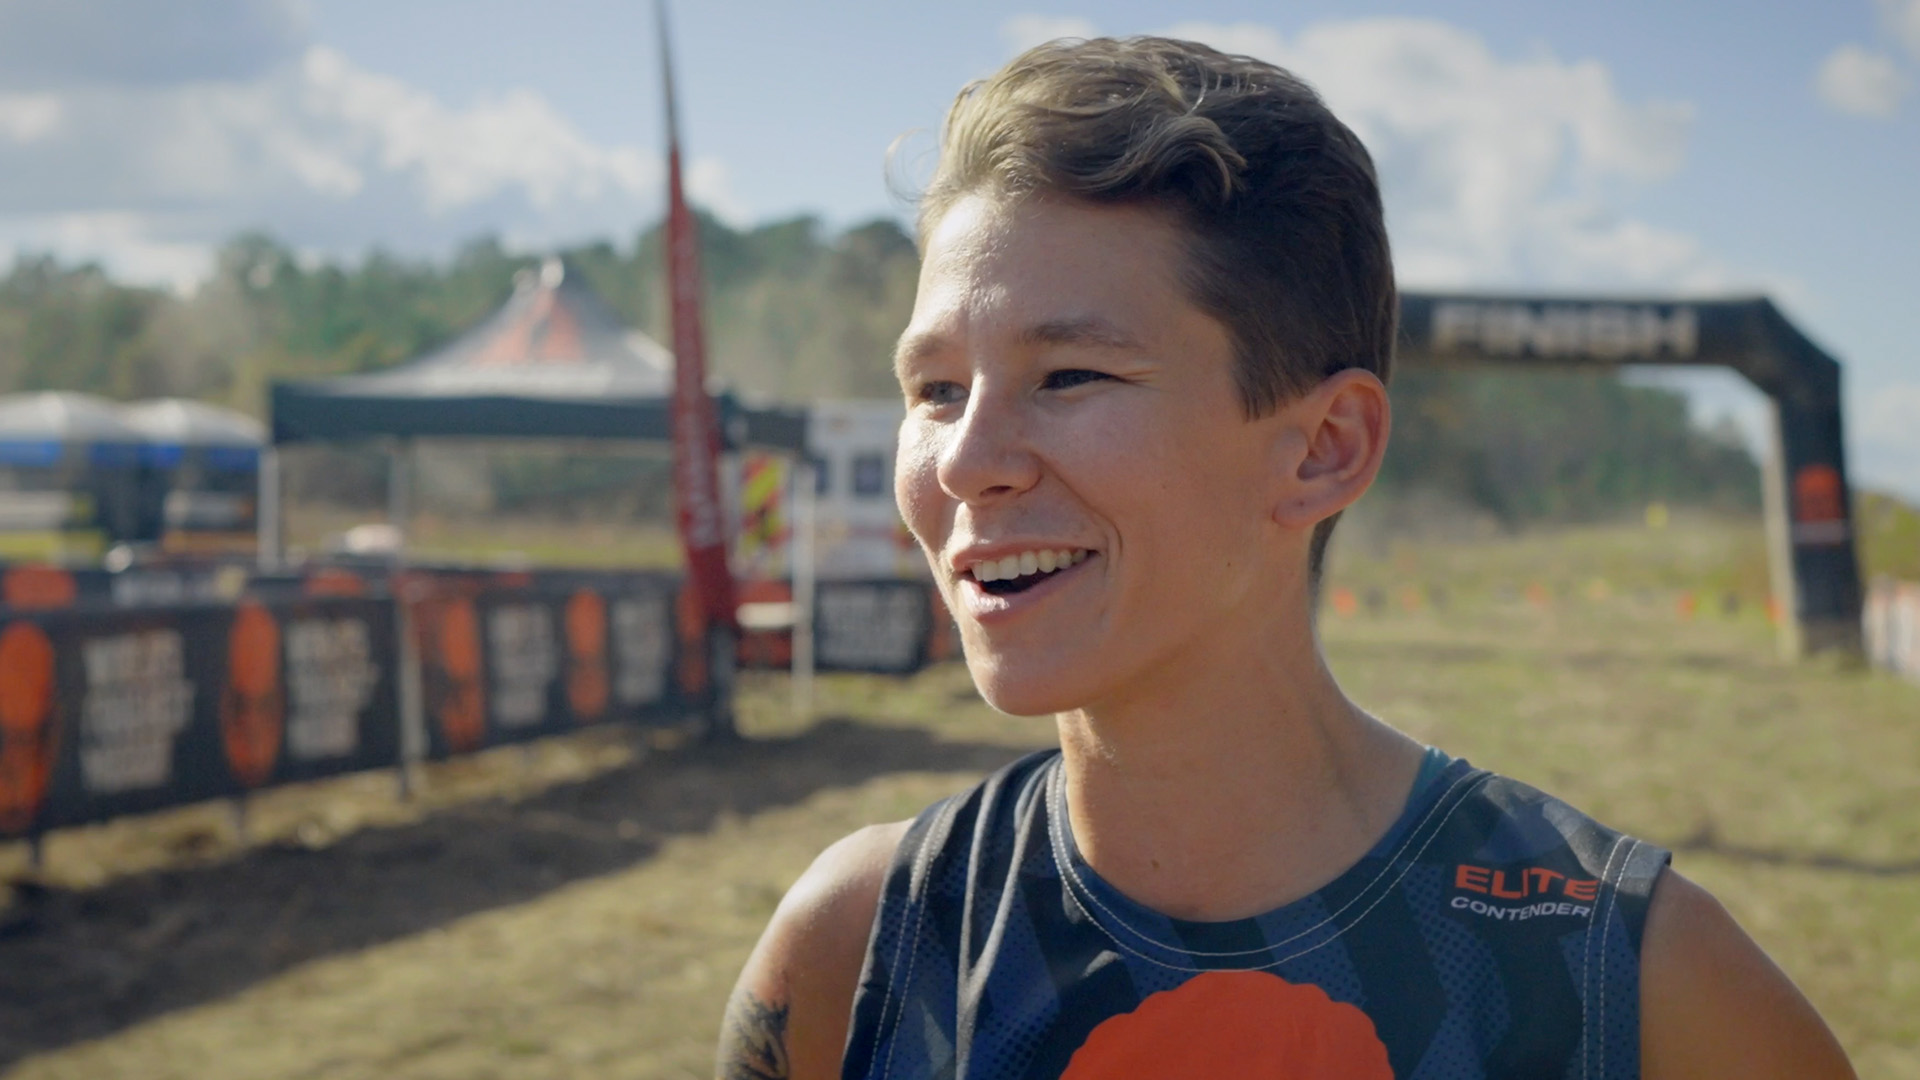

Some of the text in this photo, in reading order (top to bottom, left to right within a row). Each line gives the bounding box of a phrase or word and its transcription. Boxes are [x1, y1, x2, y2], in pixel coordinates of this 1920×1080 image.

[1432, 304, 1697, 357] FINISH
[1455, 864, 1599, 901] ELITE
[1450, 896, 1590, 921] CONTENDER
